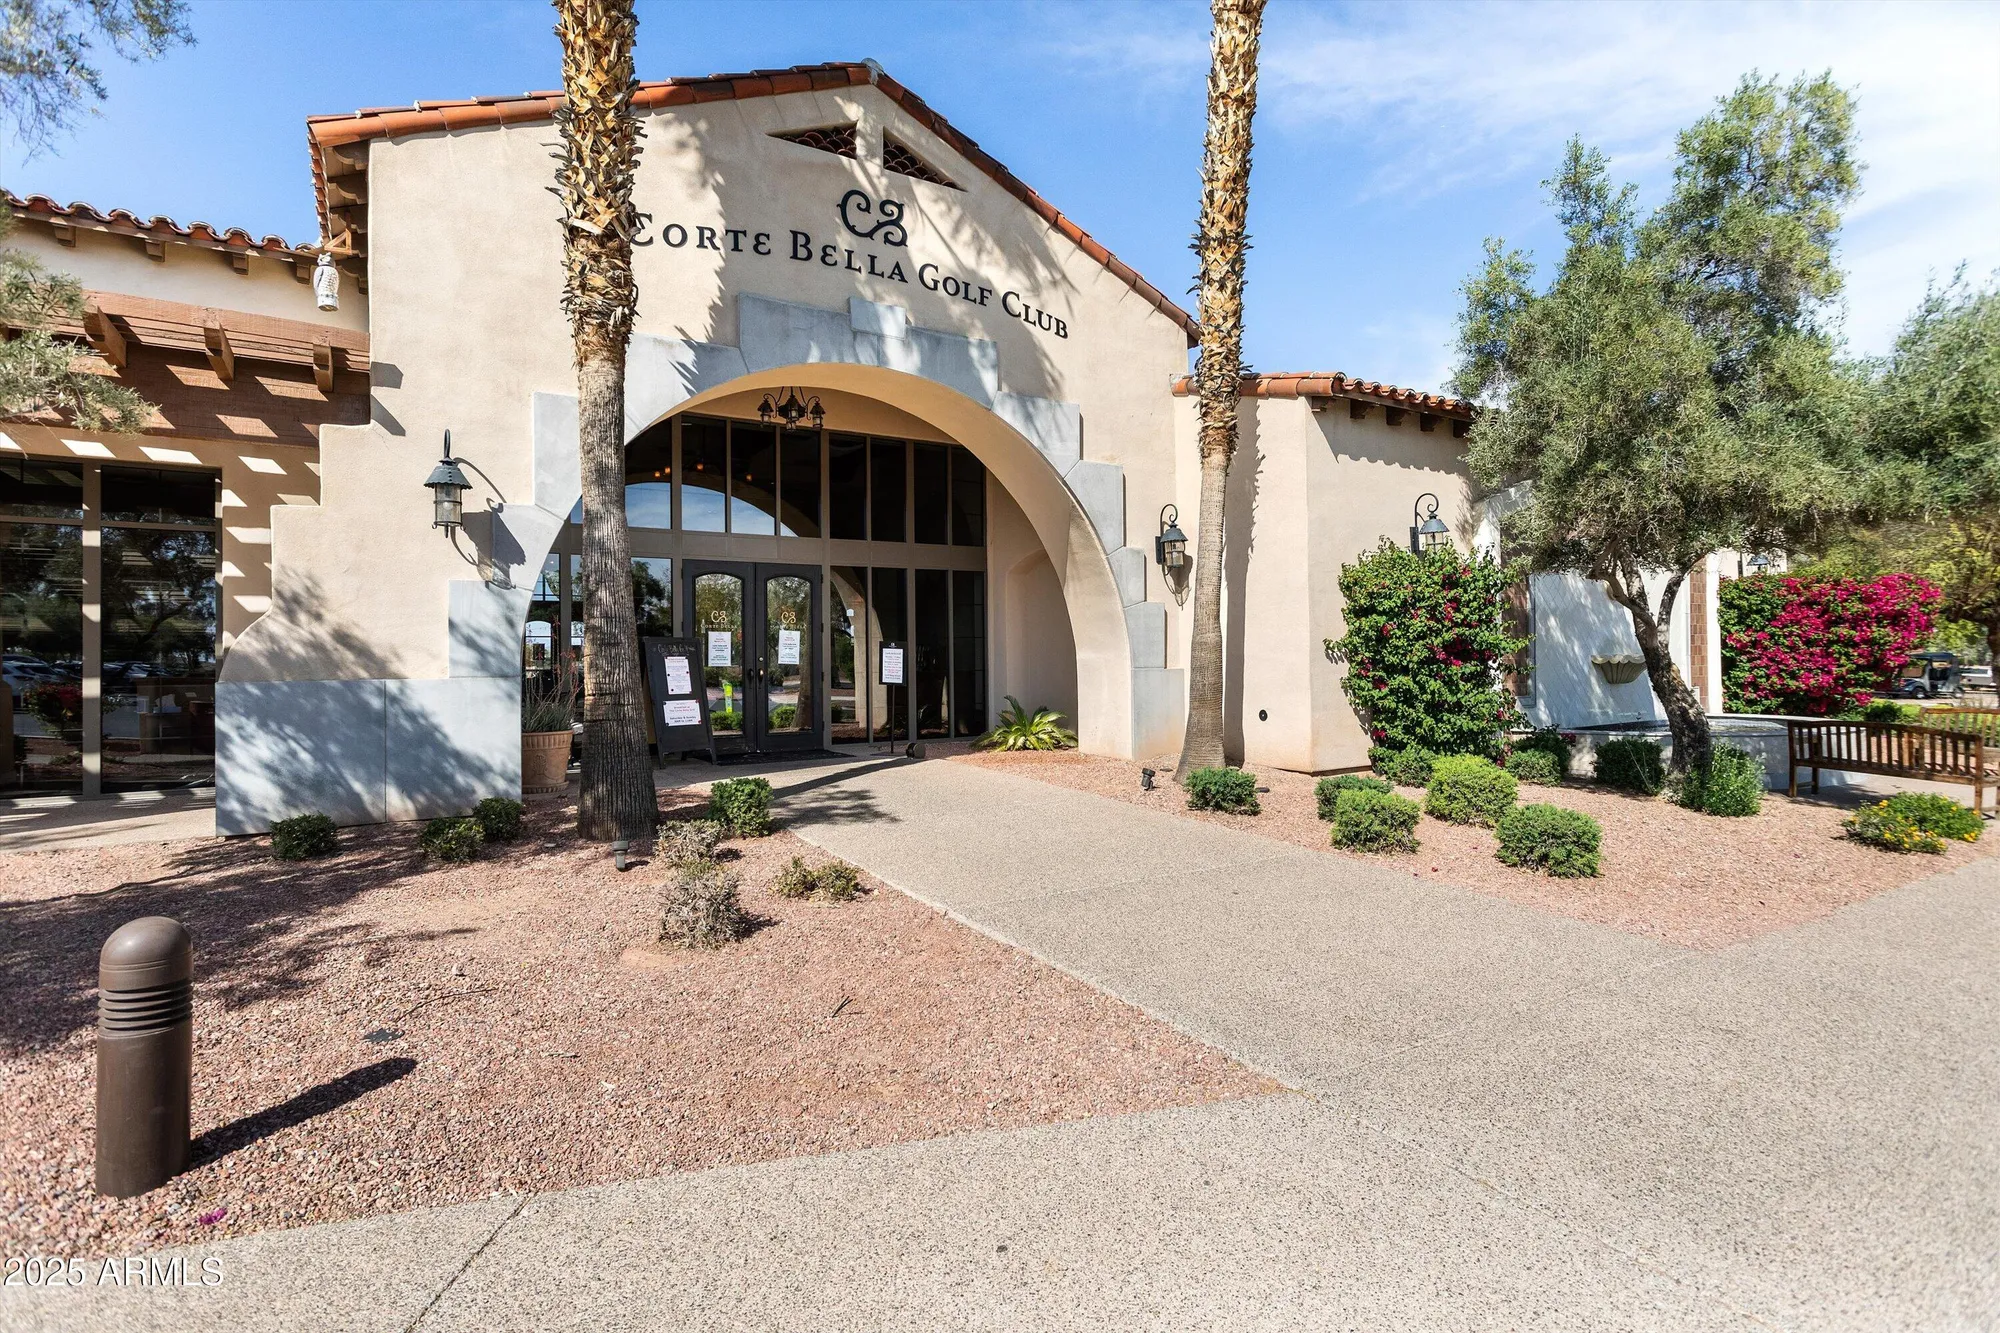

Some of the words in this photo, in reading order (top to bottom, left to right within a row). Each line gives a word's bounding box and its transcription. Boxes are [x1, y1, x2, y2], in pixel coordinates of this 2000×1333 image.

[789, 229, 909, 284] BELLA
[918, 262, 993, 307] GOLF
[1001, 290, 1069, 340] CLUB
